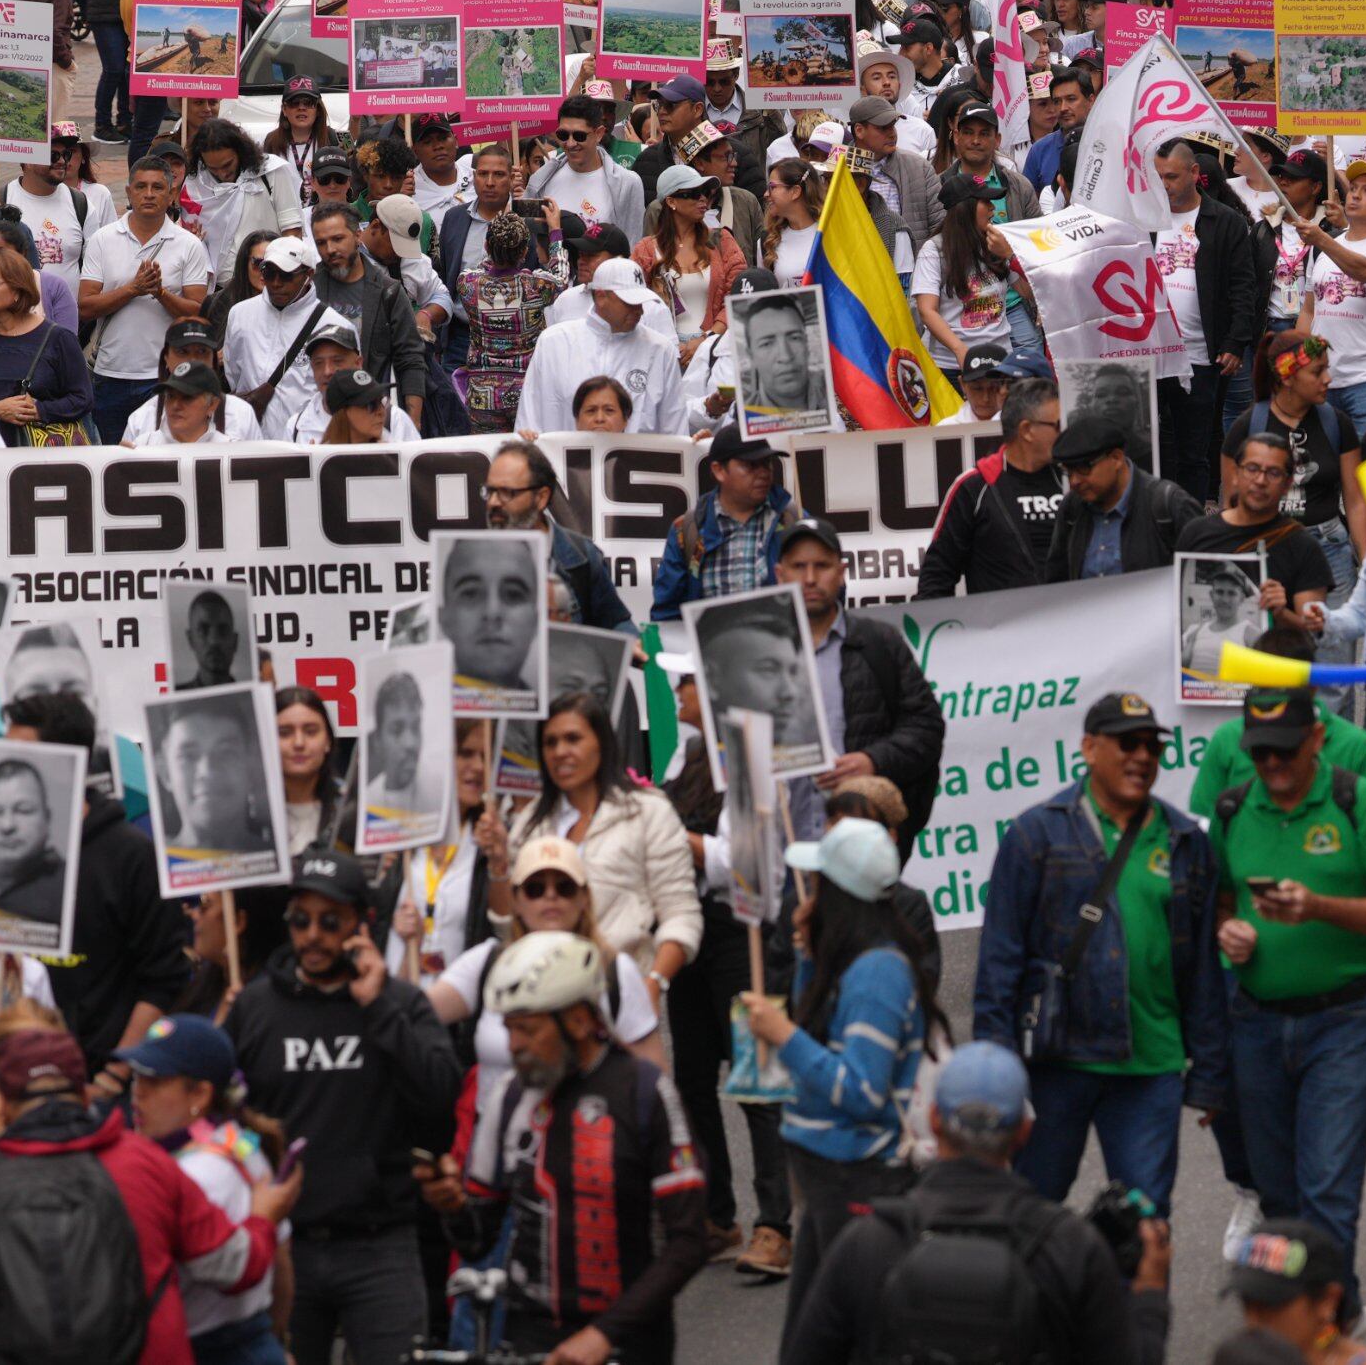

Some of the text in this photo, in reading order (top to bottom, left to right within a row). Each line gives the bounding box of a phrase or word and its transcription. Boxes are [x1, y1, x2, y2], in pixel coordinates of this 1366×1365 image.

[753, 0, 842, 10] la revolución agraria
[1281, 4, 1313, 12] Municipio:
[1056, 213, 1093, 228] COLOMBIA
[1065, 225, 1105, 242] VIDA
[985, 746, 1040, 791] de
[282, 1036, 364, 1072] PAZ
